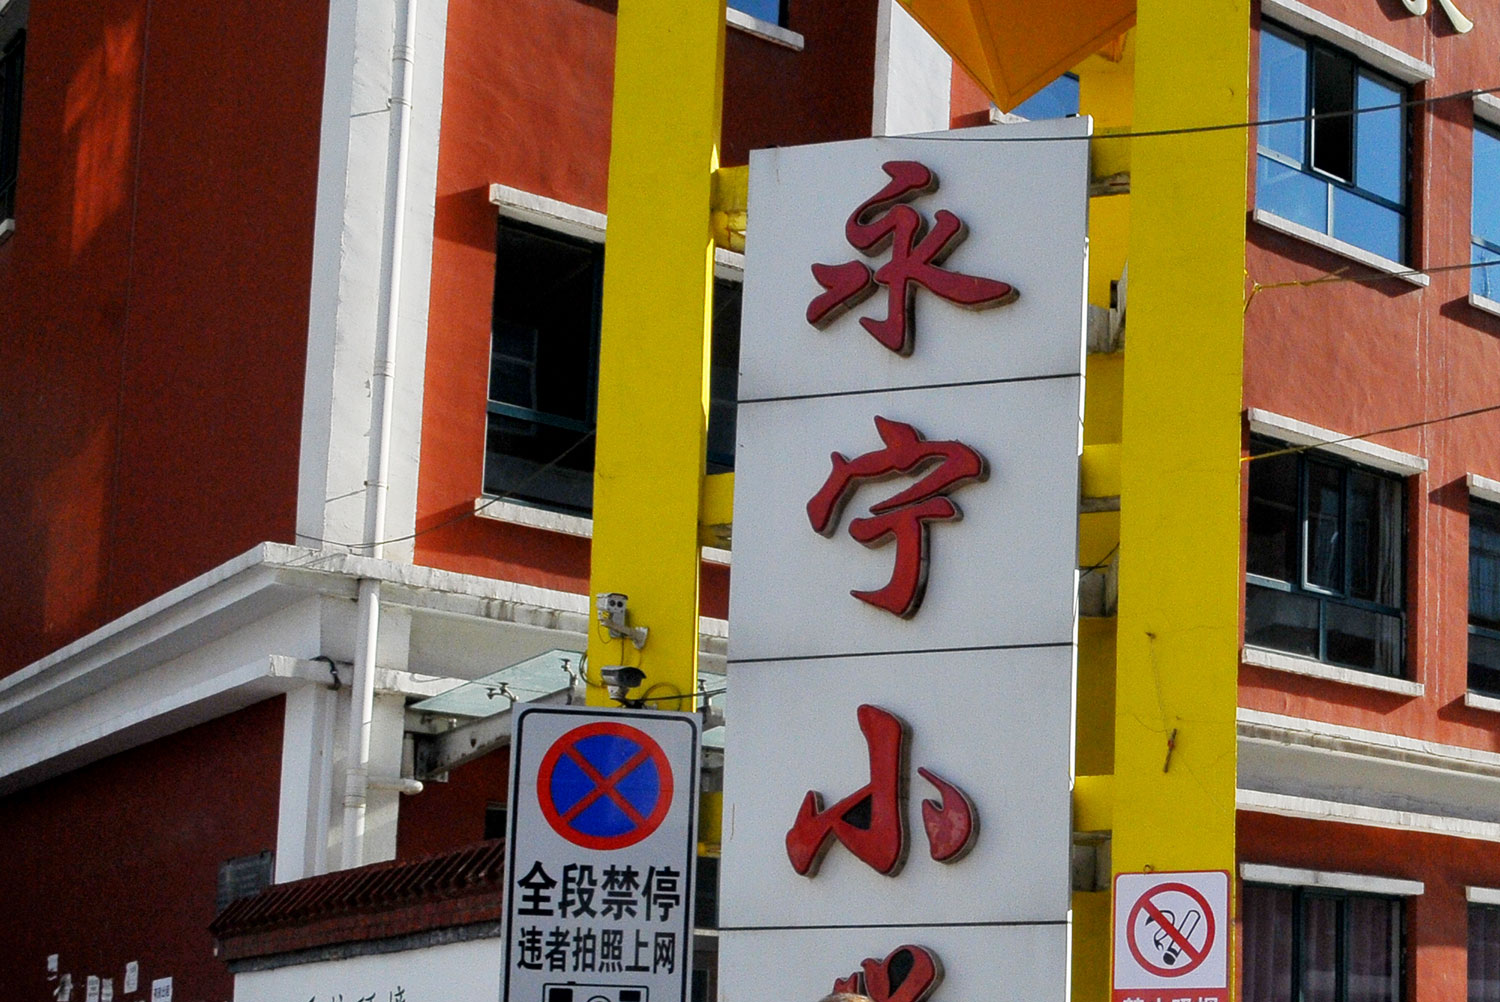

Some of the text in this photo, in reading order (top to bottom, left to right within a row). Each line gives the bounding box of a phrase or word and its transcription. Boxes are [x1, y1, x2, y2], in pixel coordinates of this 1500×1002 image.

[517, 859, 681, 922] 全段禁停
[516, 925, 677, 975] 违者拍照上网
